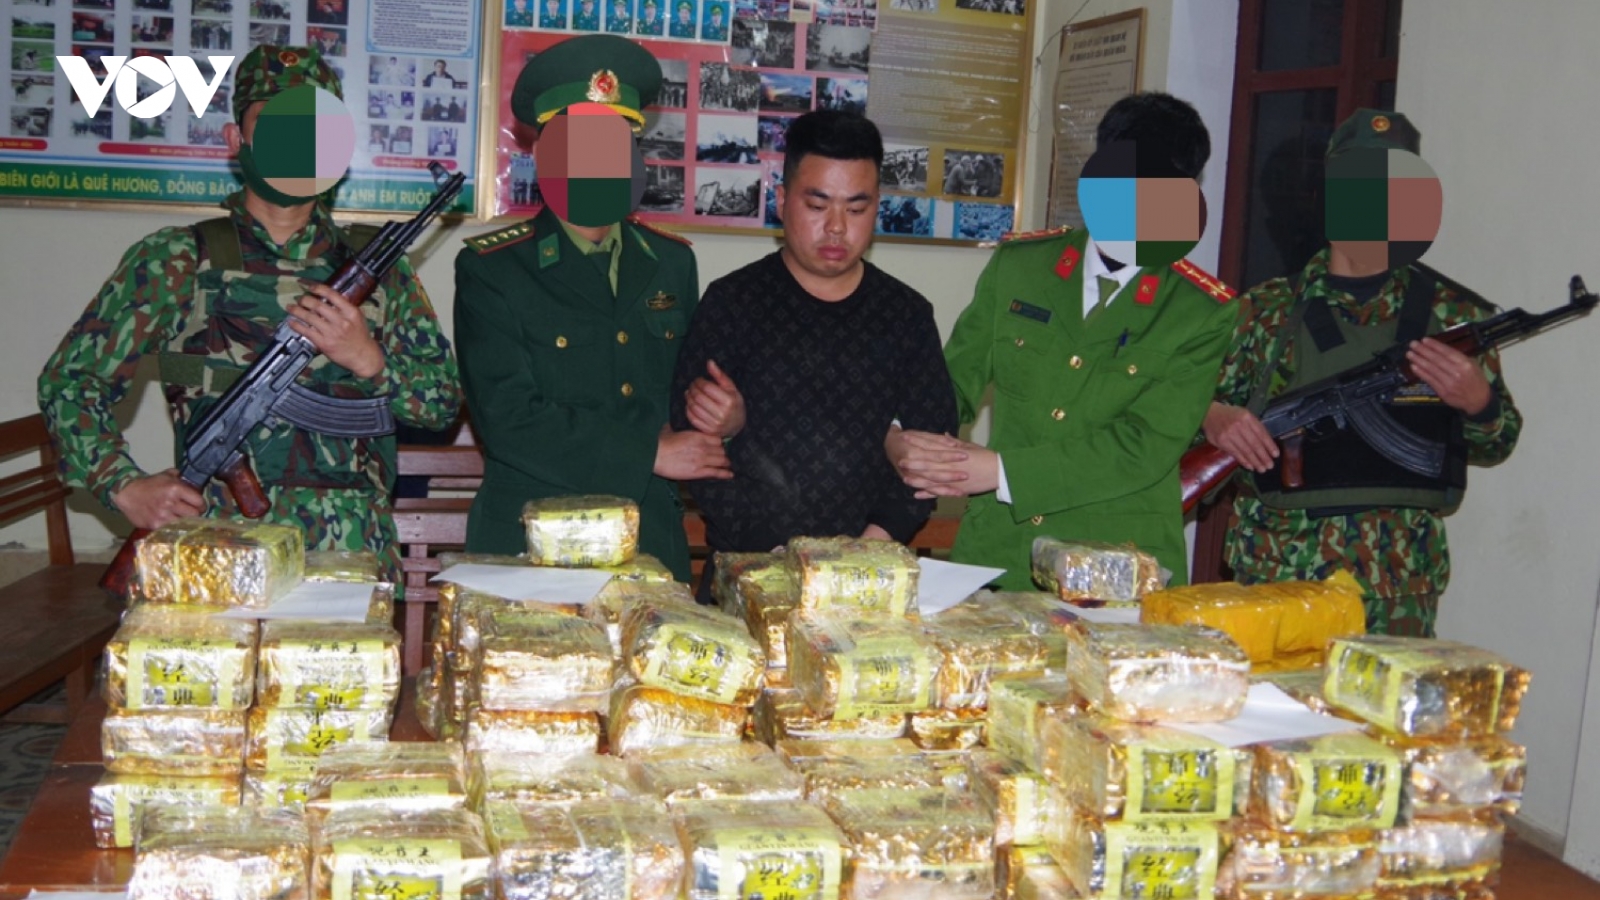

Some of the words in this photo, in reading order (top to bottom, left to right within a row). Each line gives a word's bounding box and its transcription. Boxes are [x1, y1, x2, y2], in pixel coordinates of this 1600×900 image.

[0, 169, 27, 187] BIÊN
[31, 170, 60, 189] GIỚI
[64, 172, 79, 190] LÀ
[83, 172, 108, 192] QUÊ
[167, 174, 205, 194] ĐỒNG
[352, 188, 376, 203] ANH
[380, 190, 397, 205] EM
